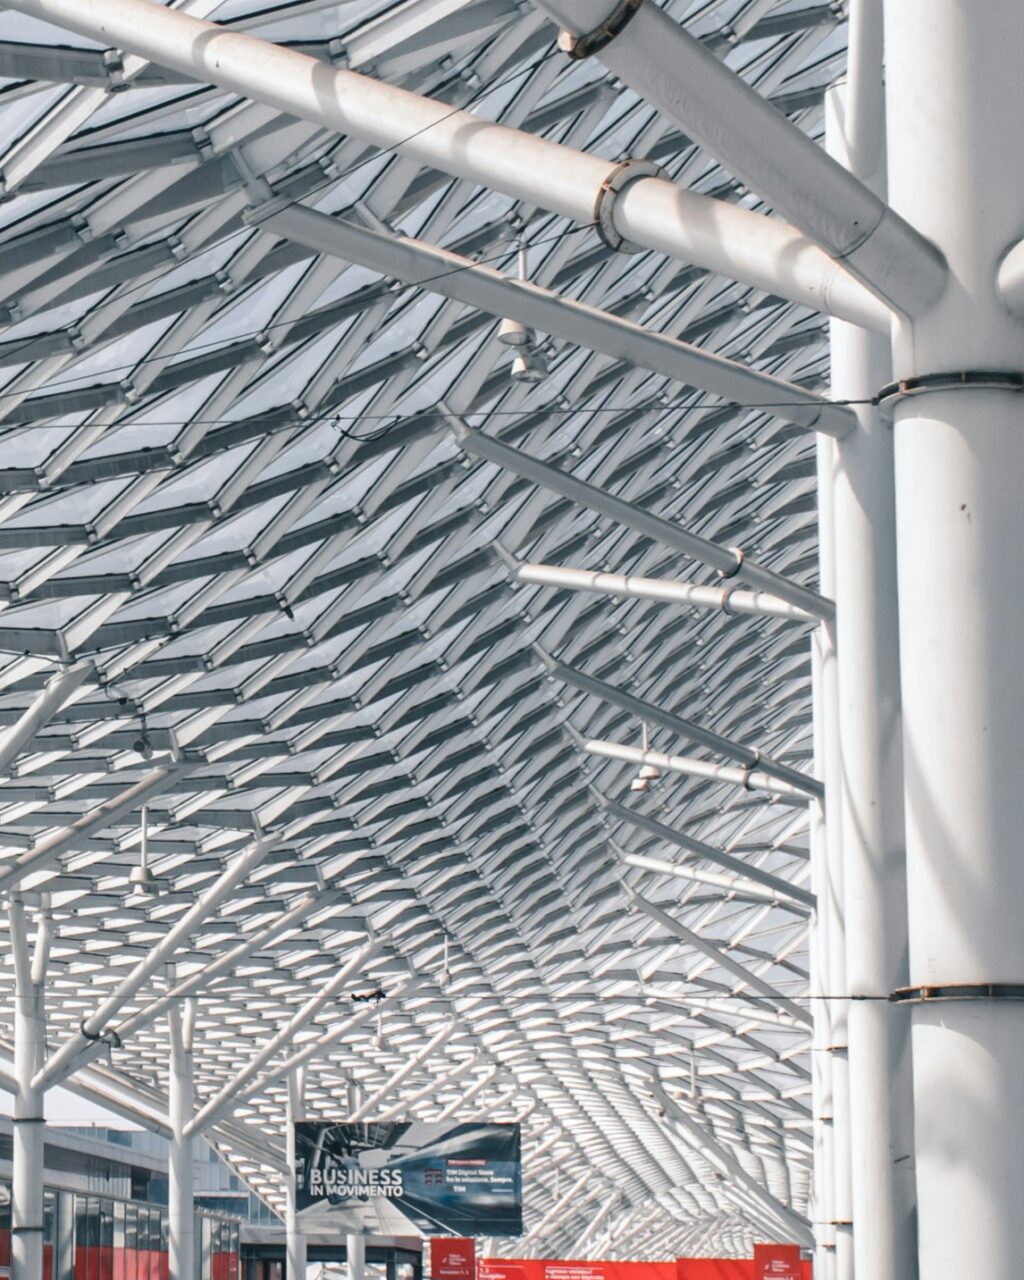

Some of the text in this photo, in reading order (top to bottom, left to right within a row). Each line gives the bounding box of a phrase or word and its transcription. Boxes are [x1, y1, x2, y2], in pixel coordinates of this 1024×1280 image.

[310, 1168, 403, 1185] BUSINESS
[310, 1185, 404, 1197] IN MOVIMENTO
